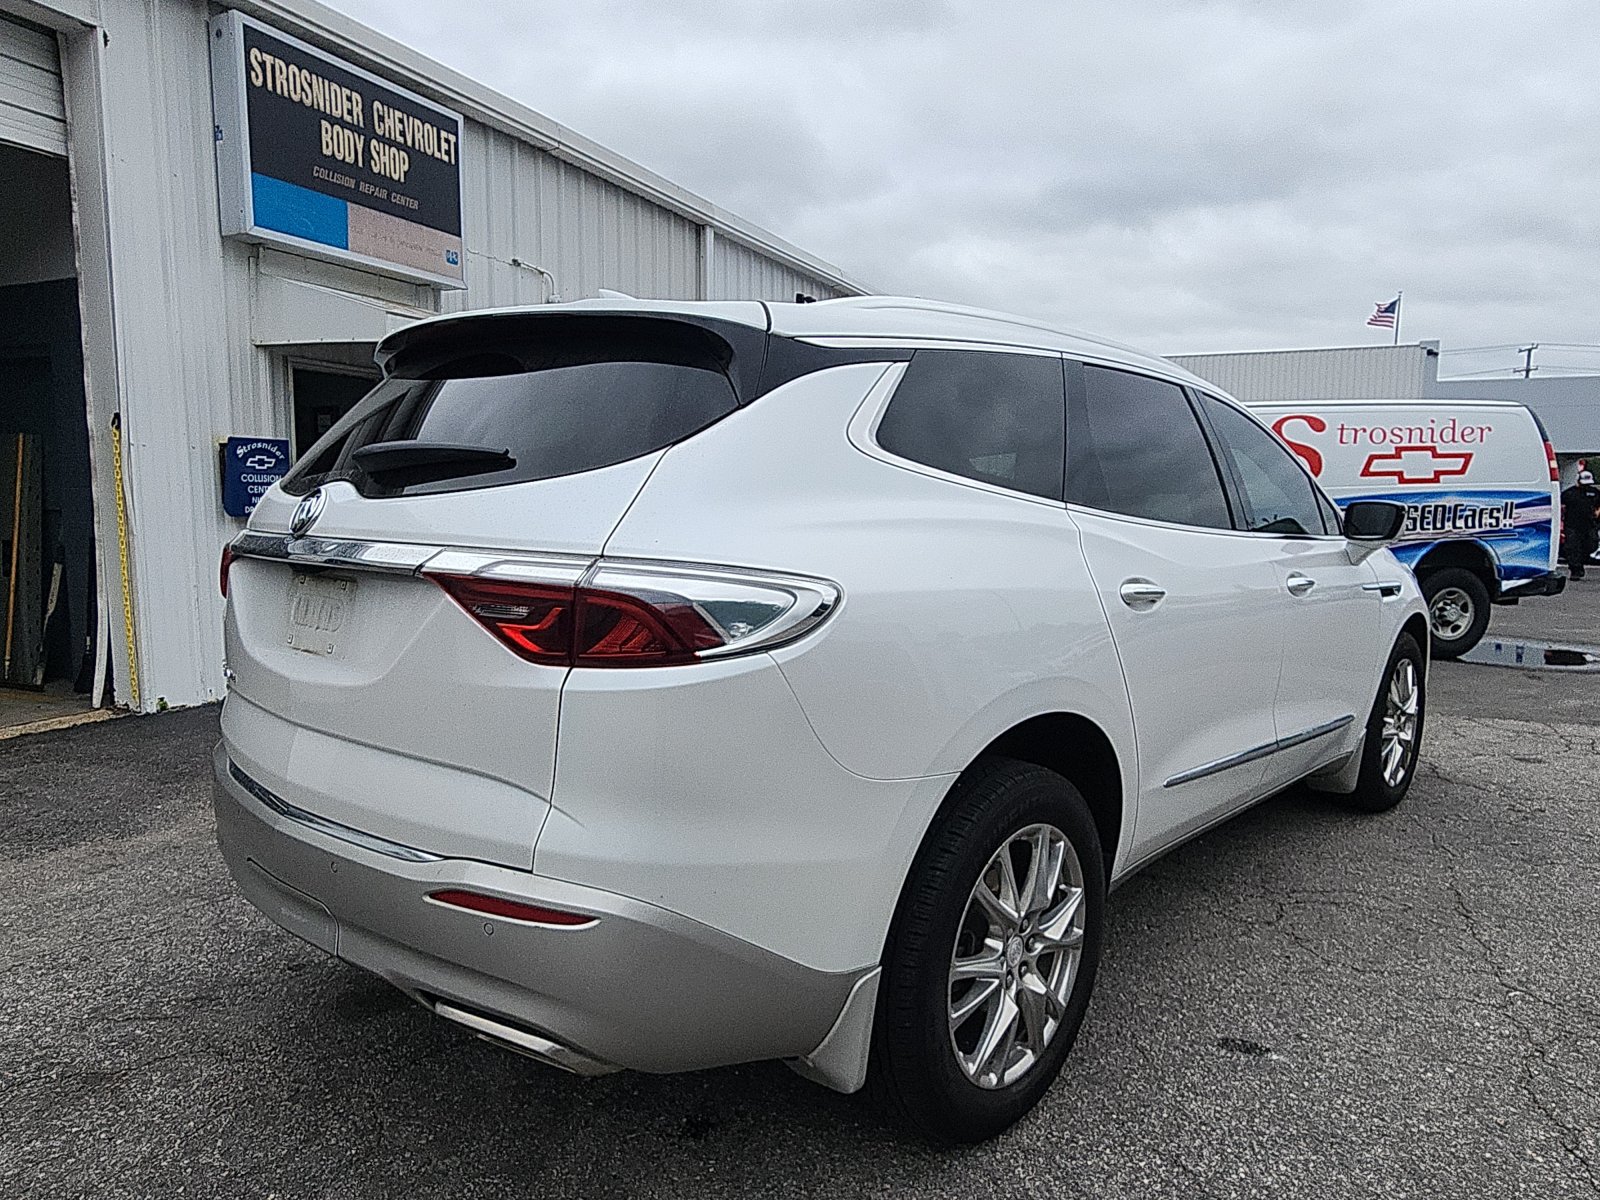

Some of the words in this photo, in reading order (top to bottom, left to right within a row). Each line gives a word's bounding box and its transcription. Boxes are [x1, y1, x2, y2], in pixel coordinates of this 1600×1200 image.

[250, 47, 364, 128] STROSNIDER
[373, 101, 457, 165] CHEVROLET
[320, 119, 365, 168] BODY
[370, 138, 409, 182] SHOP
[313, 166, 356, 189] COLLISION
[359, 182, 388, 199] REPAIR
[391, 193, 419, 210] CENTER
[236, 442, 285, 459] Strosnider
[247, 485, 271, 494] CENT
[1405, 504, 1447, 531] SED
[1451, 502, 1514, 530] Cars!!
